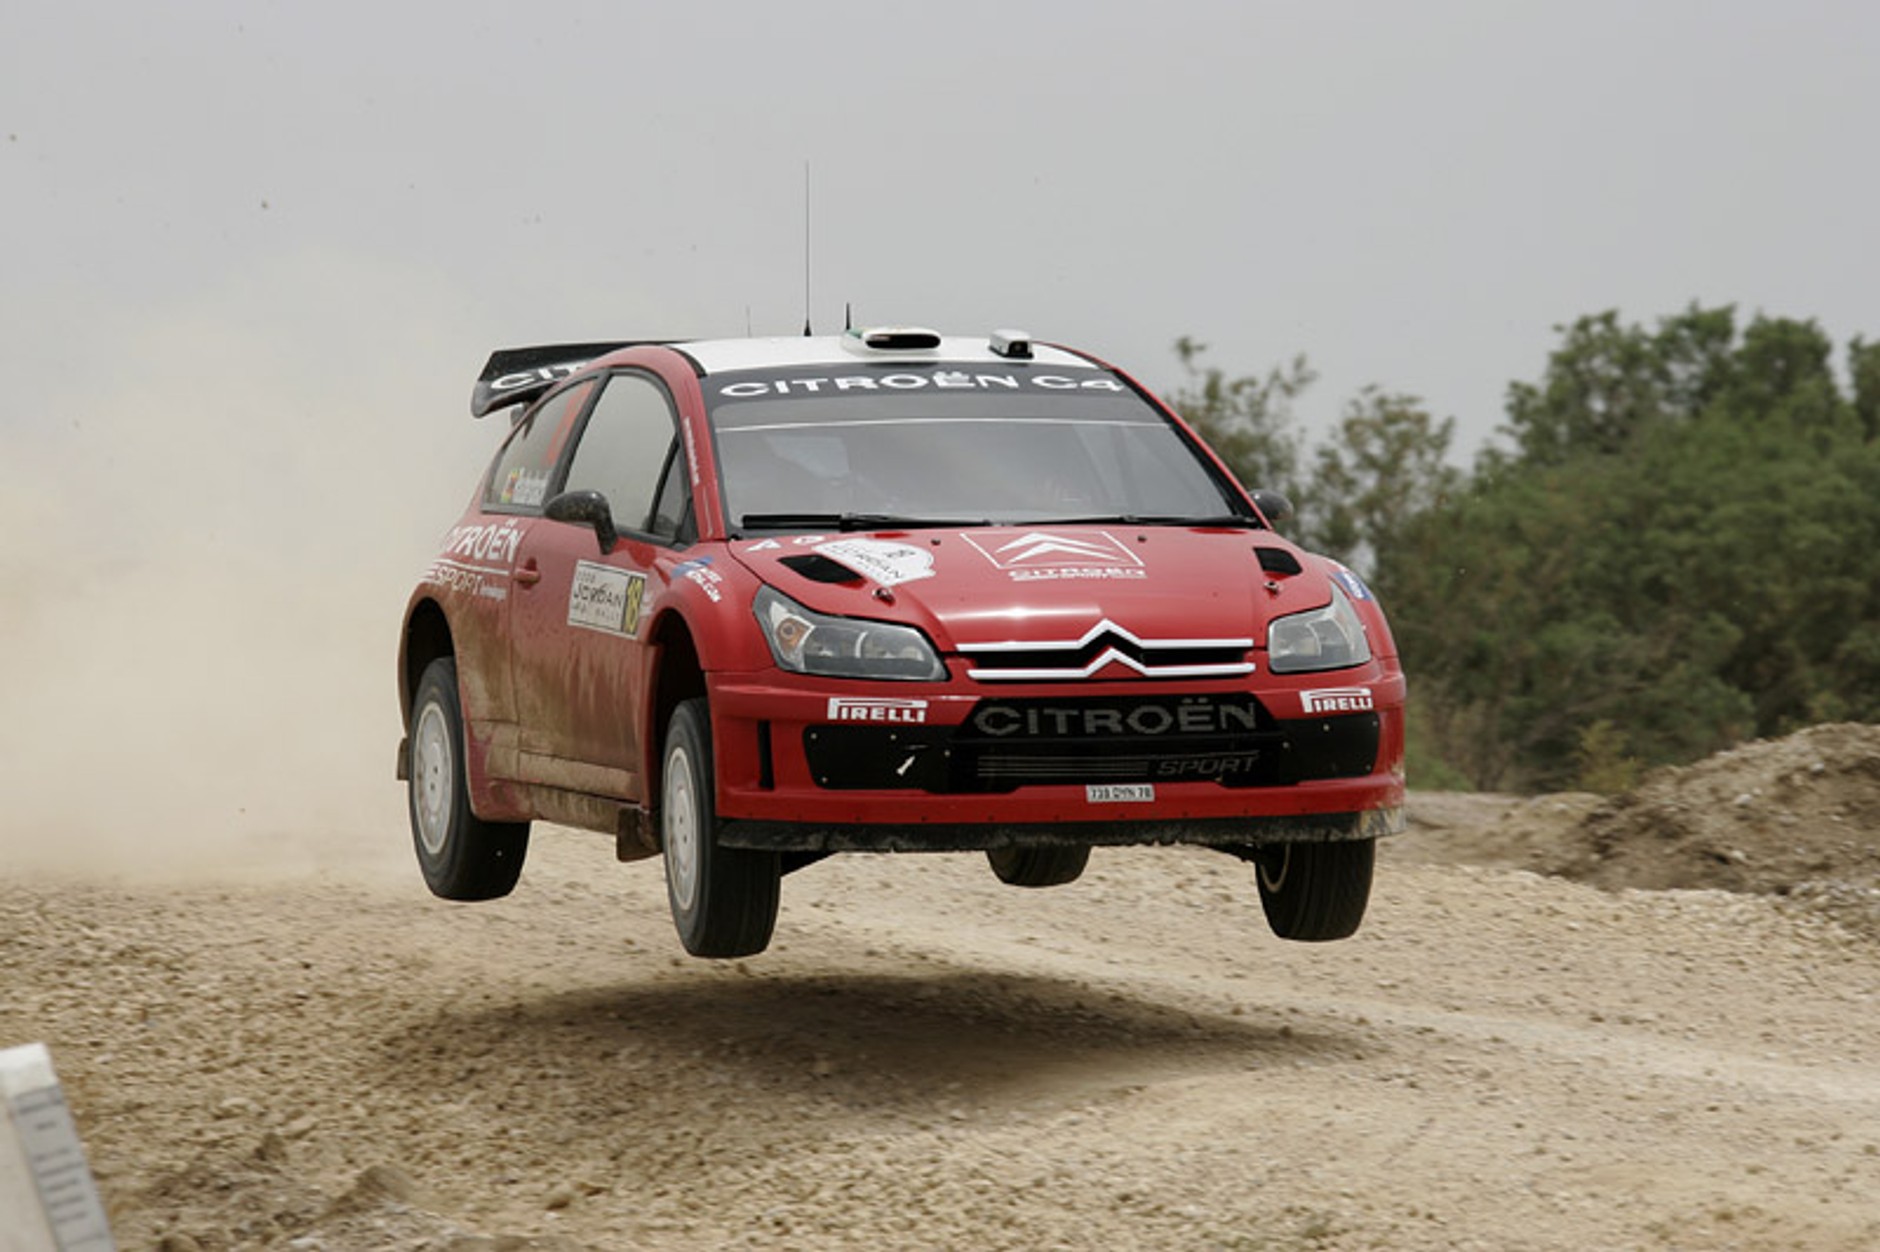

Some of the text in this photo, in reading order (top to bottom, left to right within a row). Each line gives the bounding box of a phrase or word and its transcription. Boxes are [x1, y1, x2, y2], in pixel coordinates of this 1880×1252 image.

[490, 362, 588, 389] CIT
[720, 370, 1124, 397] CITROËN C4
[827, 697, 928, 723] PIRELLI
[1299, 688, 1374, 713] PIRELLI
[973, 698, 1257, 735] CITROËN
[1157, 751, 1260, 776] SPORT
